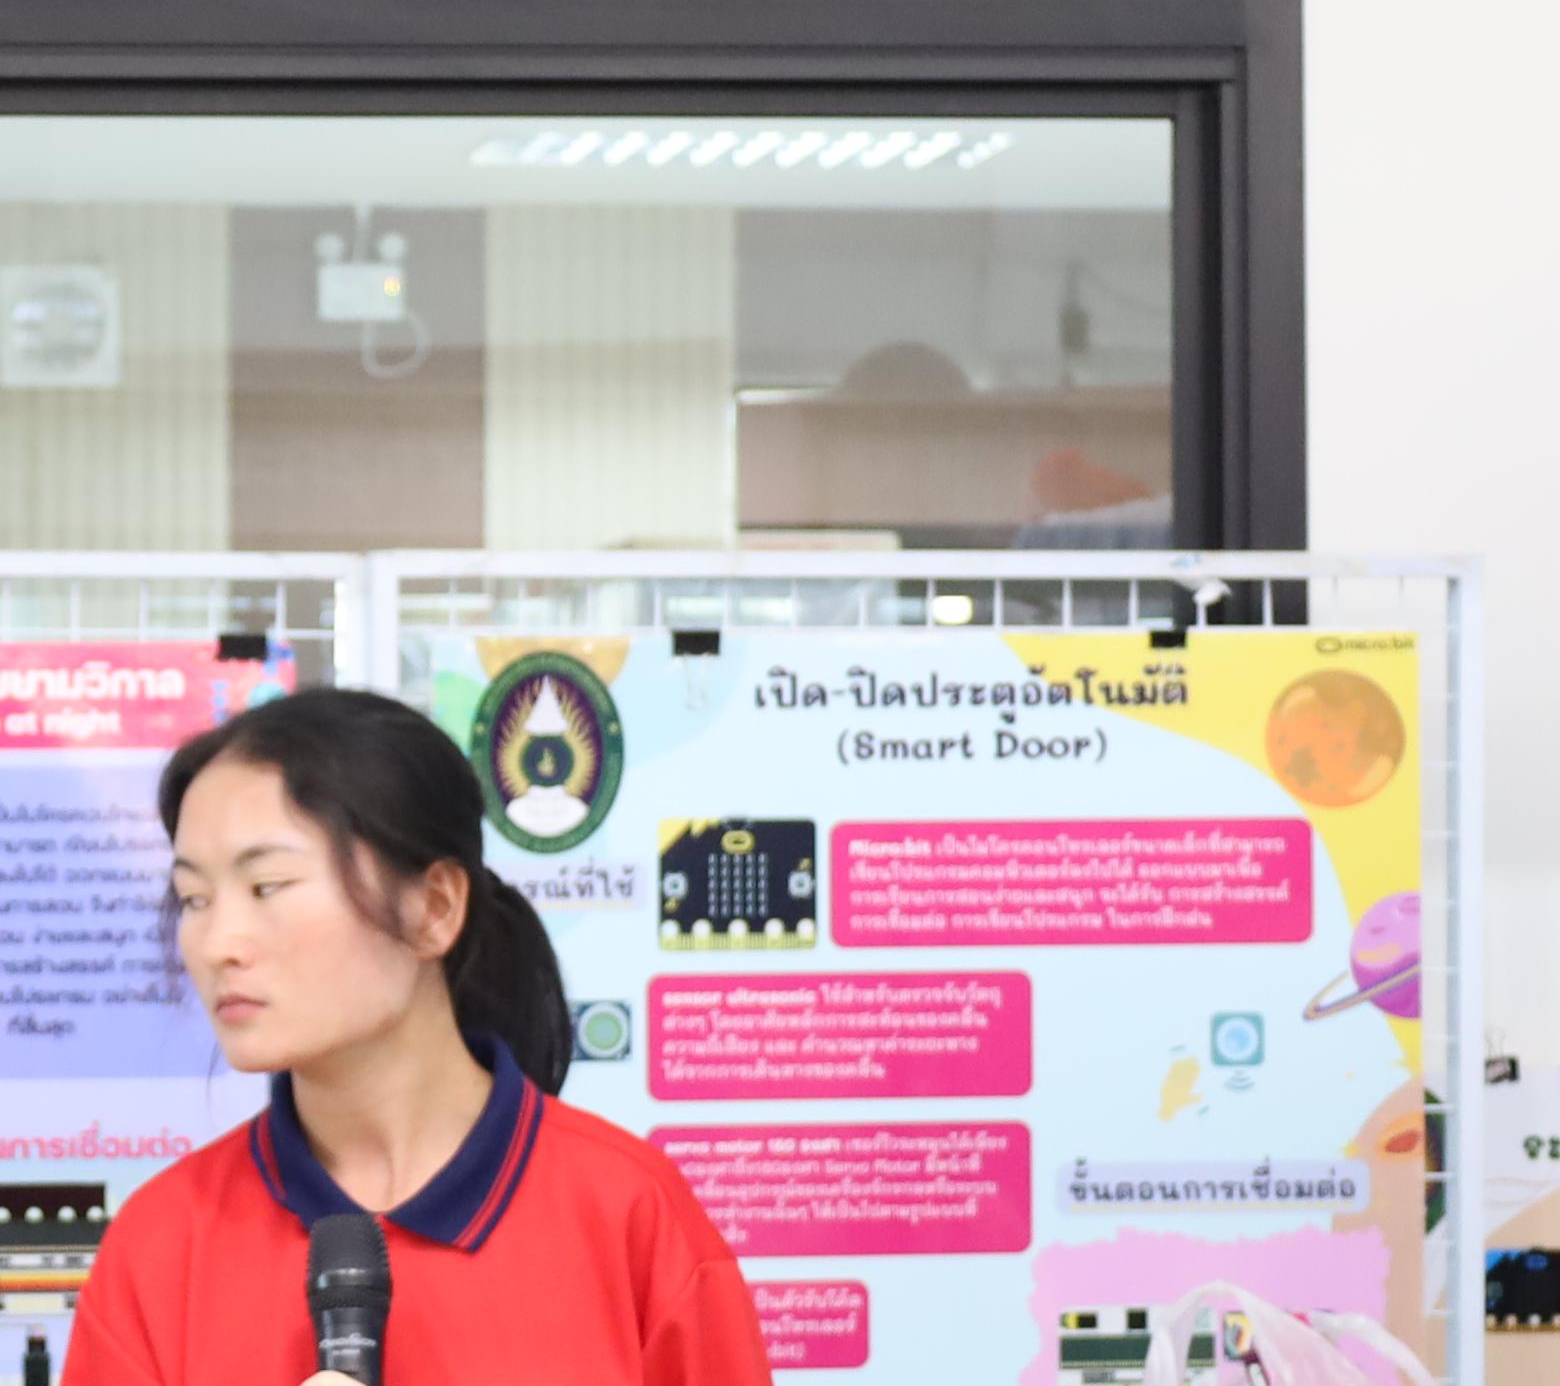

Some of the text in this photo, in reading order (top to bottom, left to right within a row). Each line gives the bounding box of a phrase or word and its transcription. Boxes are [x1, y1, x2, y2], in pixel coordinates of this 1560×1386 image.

[5, 712, 40, 736] at
[44, 711, 123, 739] night
[836, 726, 1109, 766] (Smart Door)
[1068, 1155, 1357, 1203] ขั้นตอนการเชื่อมต่อ
